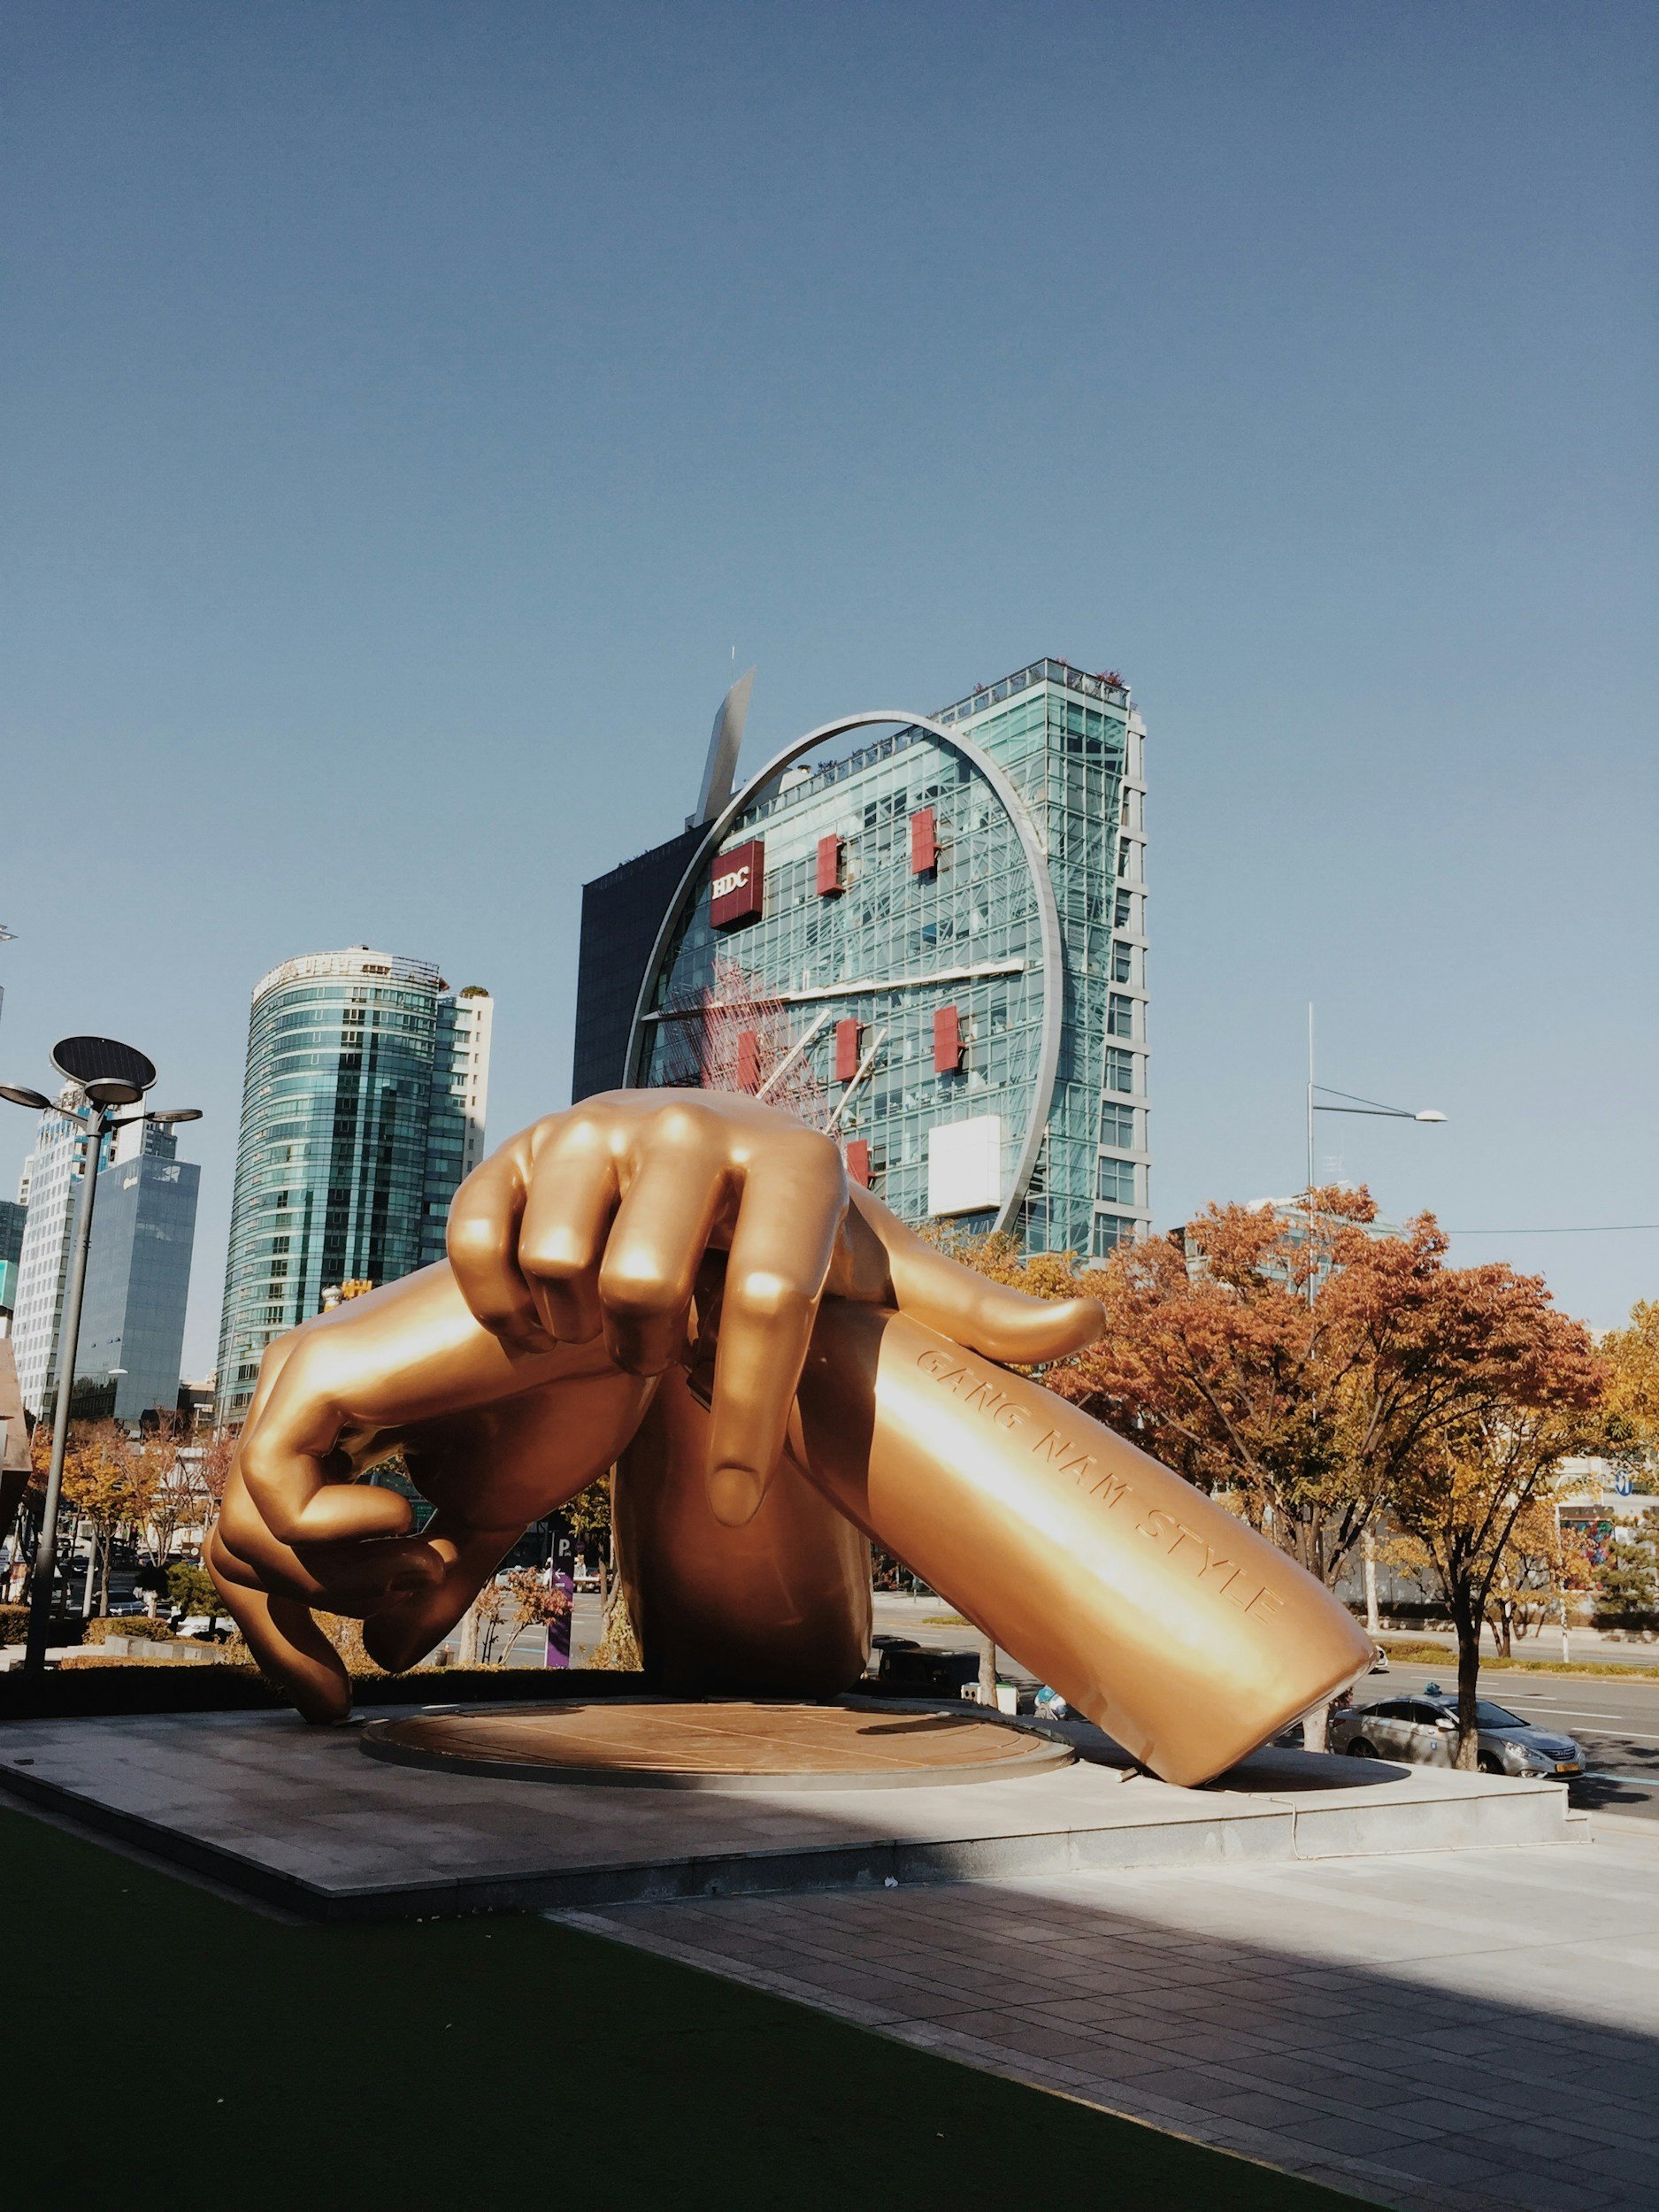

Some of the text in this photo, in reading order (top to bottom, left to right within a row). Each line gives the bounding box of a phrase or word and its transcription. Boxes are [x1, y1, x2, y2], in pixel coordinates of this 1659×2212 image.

[711, 865, 749, 900] HDC
[918, 1350, 1286, 1625] GANG NAM STYLE
[558, 1538, 570, 1557] P
